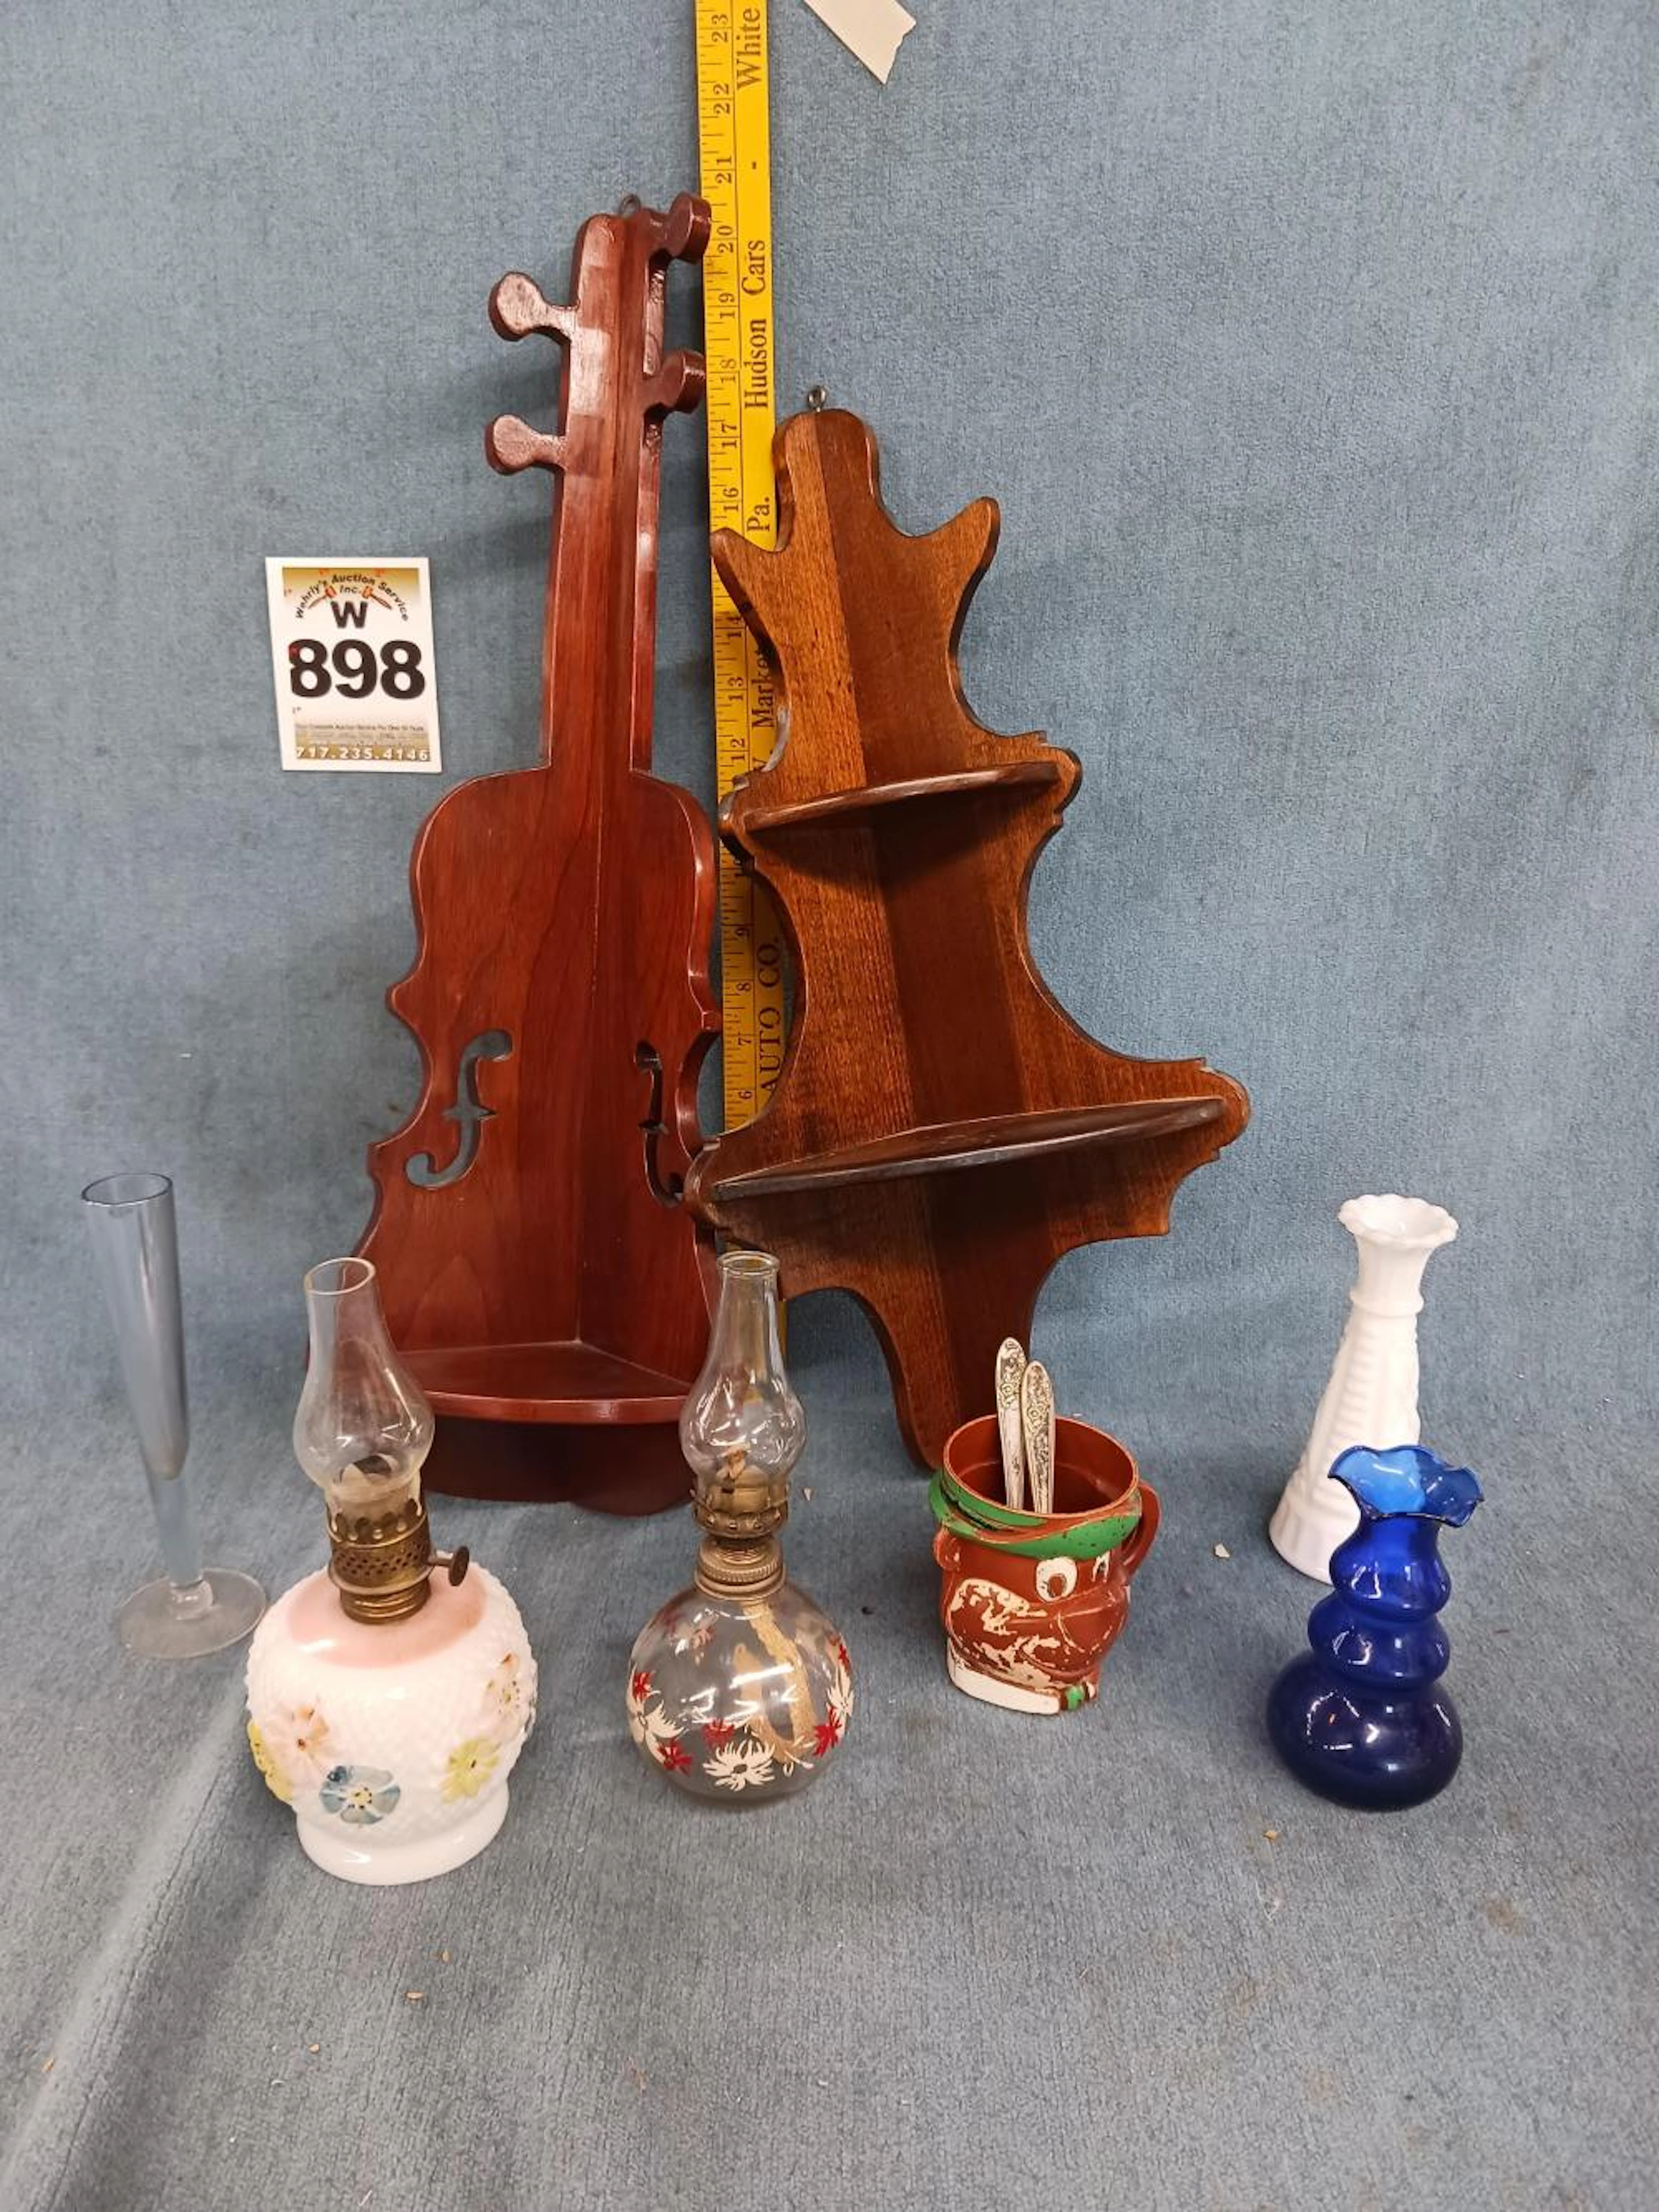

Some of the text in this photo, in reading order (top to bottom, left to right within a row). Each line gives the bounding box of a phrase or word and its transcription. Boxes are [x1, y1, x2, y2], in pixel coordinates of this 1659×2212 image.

[711, 14, 729, 42] 23
[737, 7, 762, 90] White
[713, 83, 730, 115] 22
[715, 155, 732, 184] 21
[717, 225, 734, 253] 20
[741, 240, 766, 295] Cars
[718, 293, 735, 319] 19
[720, 358, 737, 383] 18
[743, 318, 769, 408] Hudson
[721, 423, 737, 449] 17
[723, 487, 739, 512] 16
[747, 497, 770, 532] Pa.
[332, 574, 375, 586] Auction
[378, 582, 408, 621] Service
[340, 585, 361, 594] Inc.
[330, 601, 369, 629] W
[288, 639, 426, 700] 898
[728, 676, 744, 701] 13
[730, 738, 745, 765] 12
[737, 982, 751, 992] 8
[738, 1032, 752, 1046] 7
[759, 1007, 780, 1090] AUTO
[738, 1089, 752, 1099] 6
